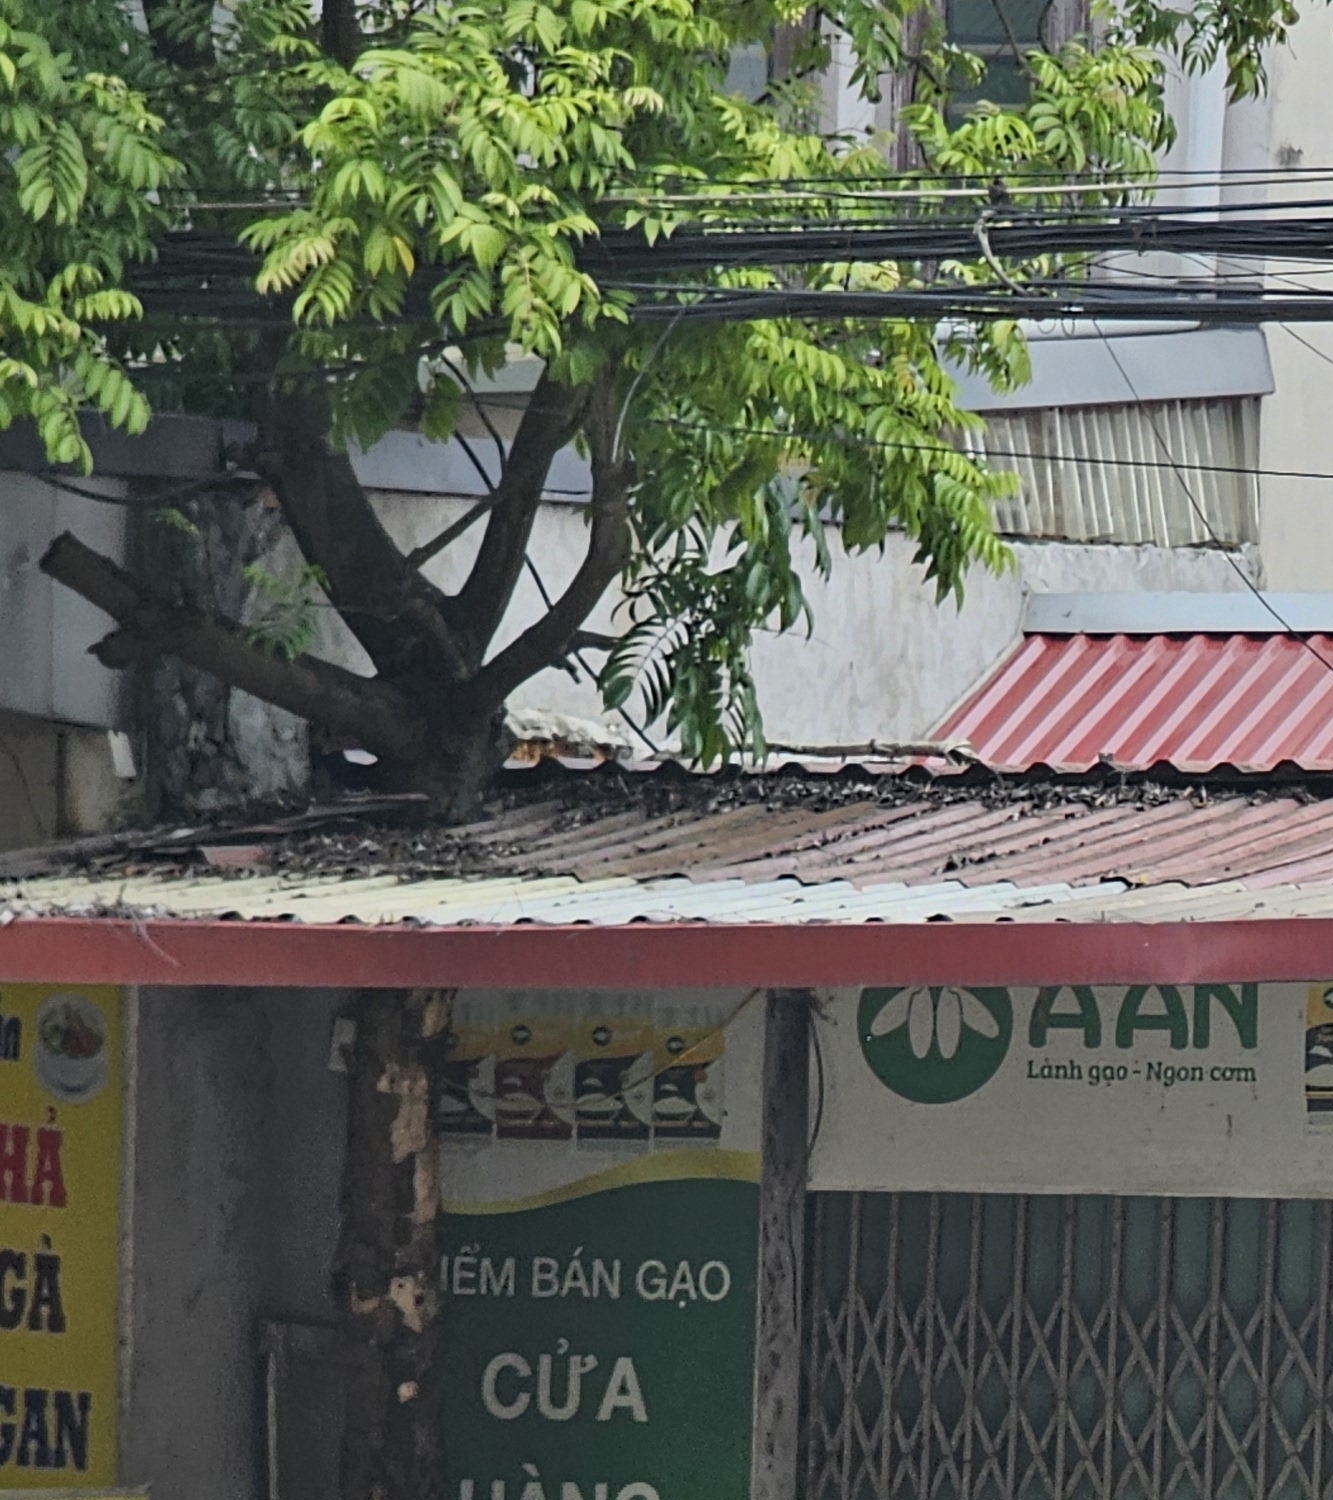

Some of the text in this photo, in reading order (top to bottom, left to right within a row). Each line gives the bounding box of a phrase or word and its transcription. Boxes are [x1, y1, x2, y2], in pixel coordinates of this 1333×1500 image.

[1027, 1059, 1083, 1080] Lành
[1088, 1064, 1128, 1087] gạo
[1146, 1062, 1204, 1086] Ngon
[441, 1243, 731, 1308] IỂM BÁN GẠO
[482, 1338, 648, 1422] CỬA
